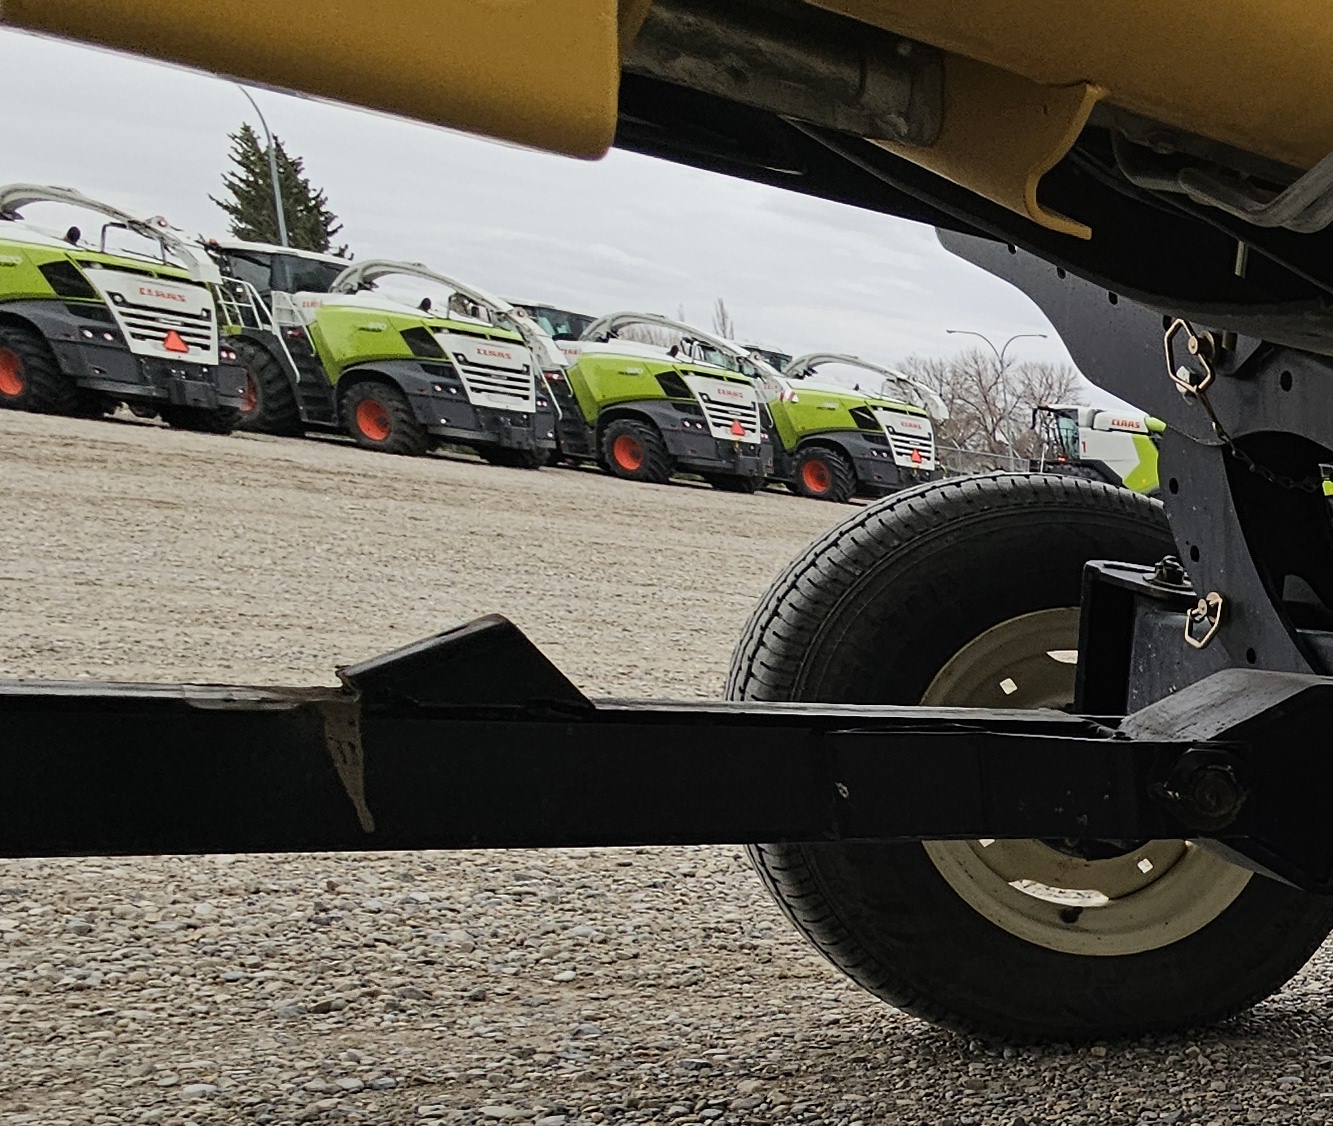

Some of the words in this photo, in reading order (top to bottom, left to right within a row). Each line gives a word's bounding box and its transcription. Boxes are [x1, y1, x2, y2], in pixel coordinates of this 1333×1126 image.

[139, 286, 186, 302] CLAAS
[476, 348, 512, 360] CLAAS
[1111, 418, 1140, 429] CLAAS
